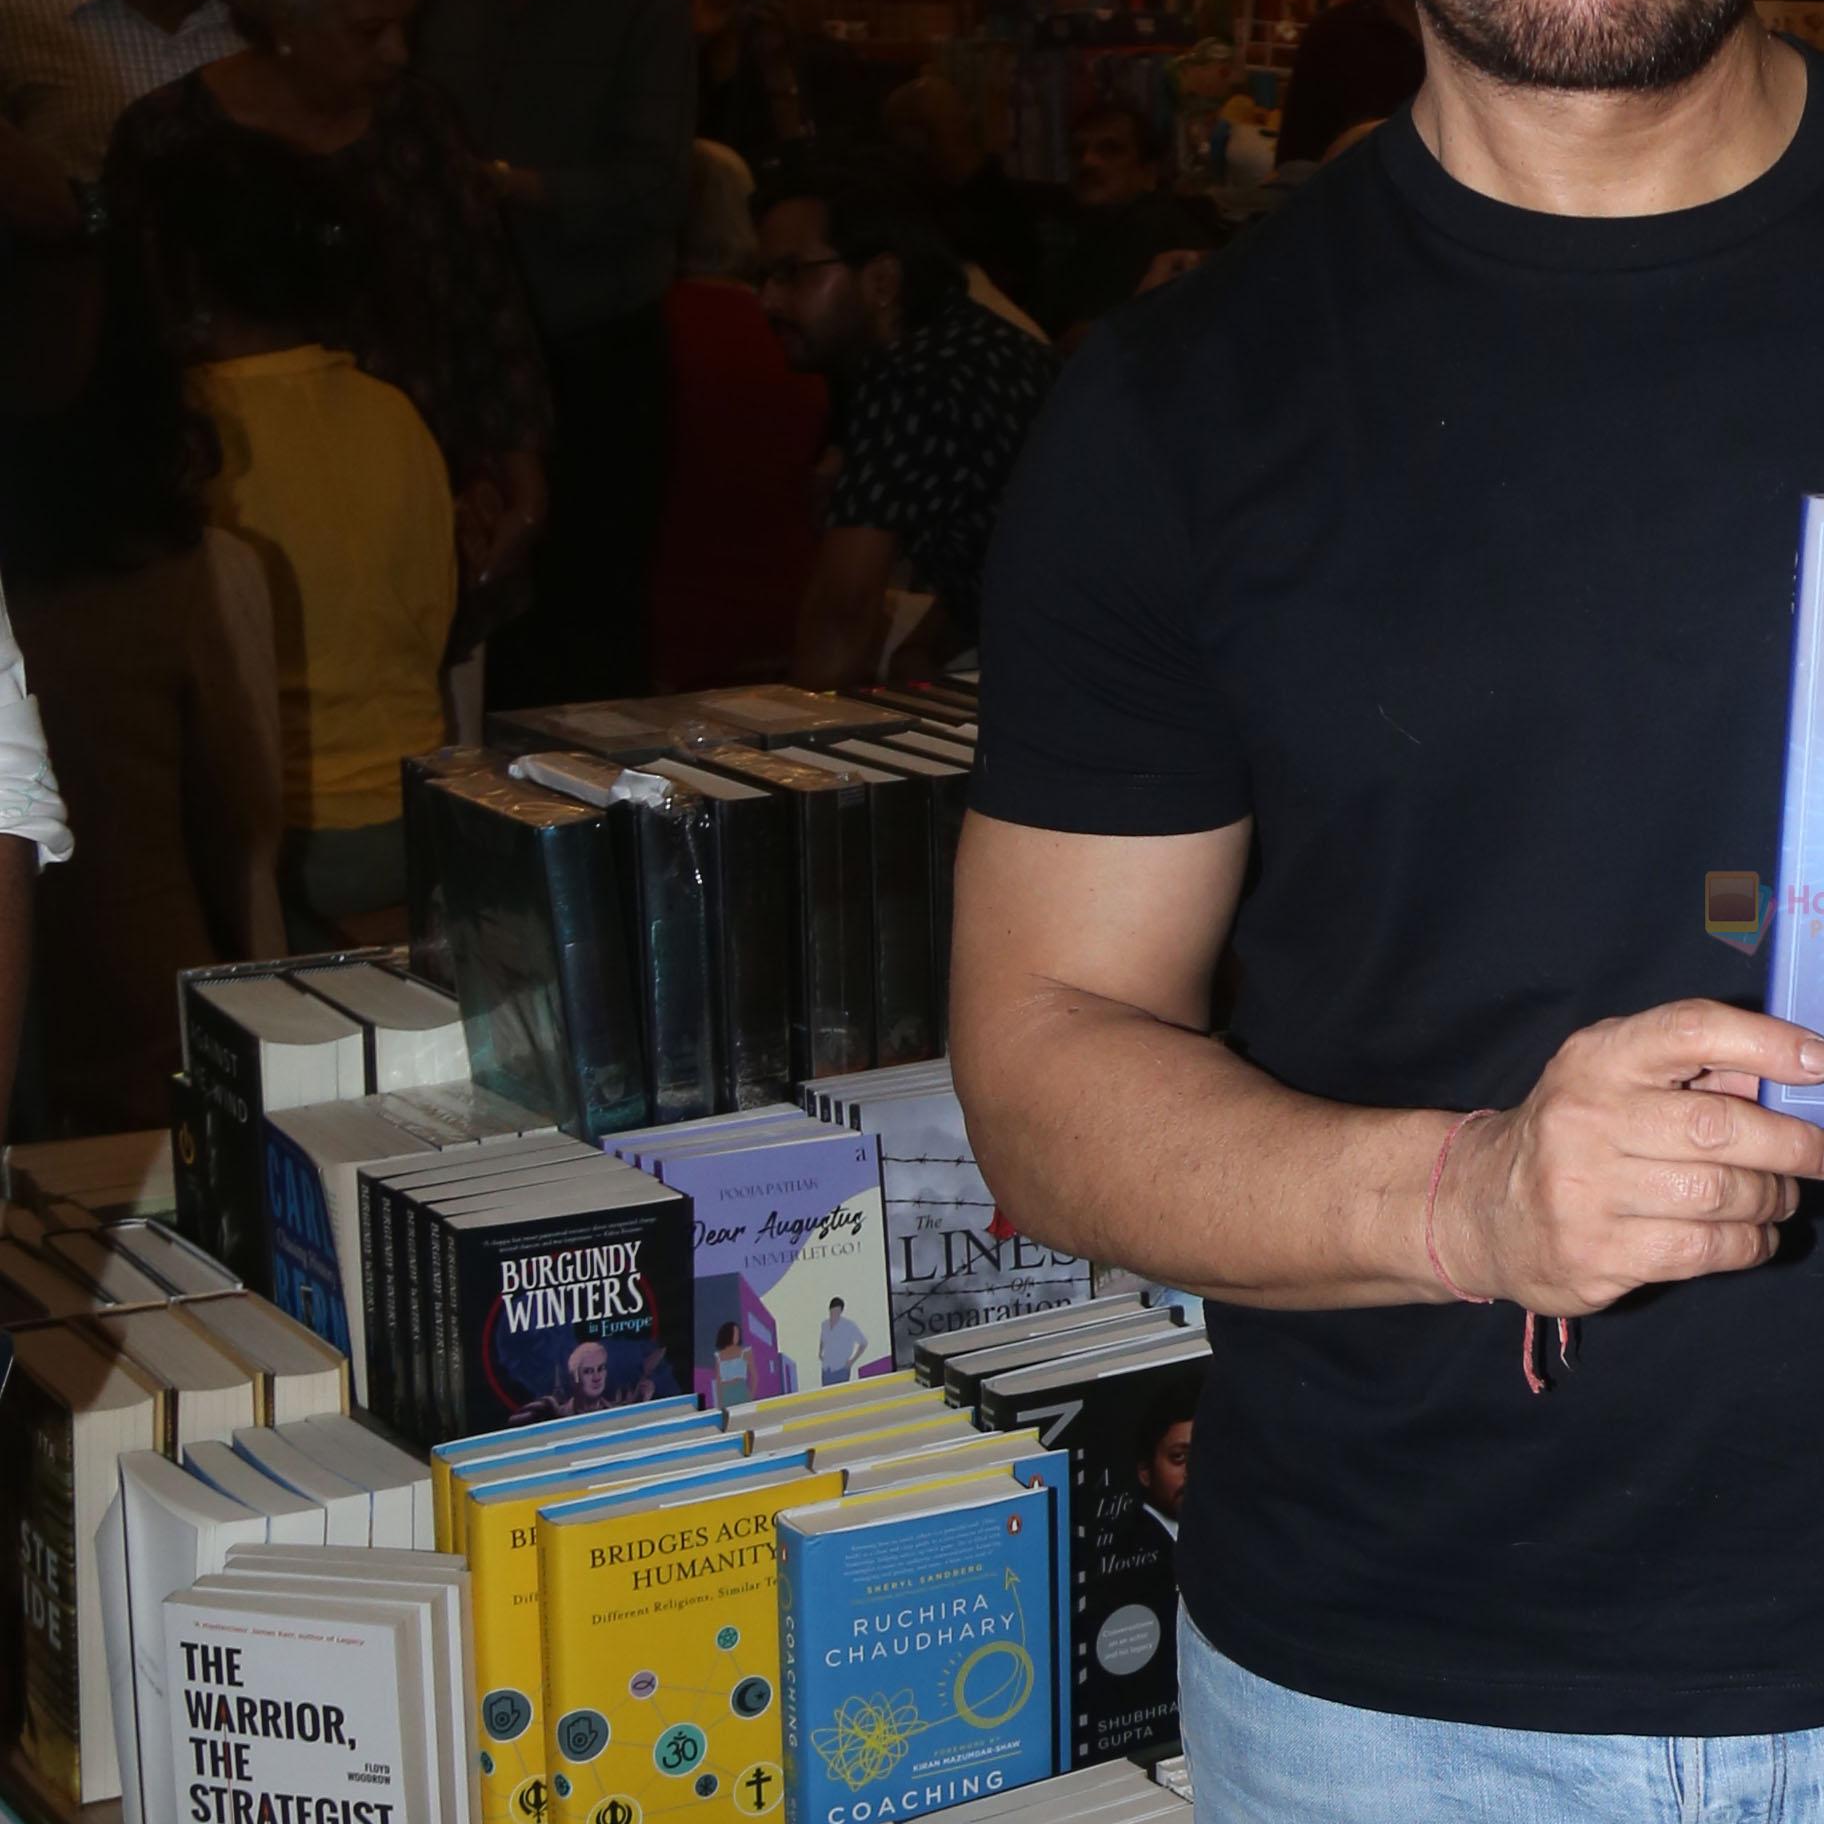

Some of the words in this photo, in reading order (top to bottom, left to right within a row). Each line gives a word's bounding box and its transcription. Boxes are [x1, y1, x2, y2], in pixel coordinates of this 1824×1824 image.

[719, 1184, 764, 1202] POOJA
[765, 1178, 820, 1197] PATHAK
[692, 1220, 746, 1251] Dear
[915, 1215, 943, 1231] The
[501, 1241, 643, 1294] BURGUNDY
[502, 1272, 644, 1334] WINTERS
[906, 1293, 1073, 1337] Separation
[589, 1323, 599, 1334] in
[601, 1316, 654, 1338] Europe
[1097, 1492, 1134, 1521] Life
[590, 1526, 709, 1569] BRIDGES
[632, 1540, 780, 1591] HUMANITY
[1098, 1547, 1160, 1575] Movies
[866, 1578, 913, 1595] SHERYL
[920, 1563, 984, 1585] SANDBERG
[591, 1605, 651, 1626] Different
[653, 1595, 714, 1613] Religions,
[717, 1580, 761, 1598] Similar
[853, 1593, 989, 1637] RUCHIRA
[824, 1612, 1017, 1668] CHAUDHARY
[180, 1642, 244, 1687] THE
[785, 1615, 799, 1748] COACHING
[184, 1689, 356, 1751] WARRIOR,
[1098, 1703, 1178, 1733] SHUBHRA
[912, 1758, 942, 1773] KIRAN
[944, 1739, 1022, 1768] MAZUMDAR-SHAW
[1098, 1725, 1154, 1751] GUPTA
[189, 1737, 253, 1782] THE
[364, 1763, 391, 1775] FLOYD
[347, 1773, 391, 1785] WOODROW
